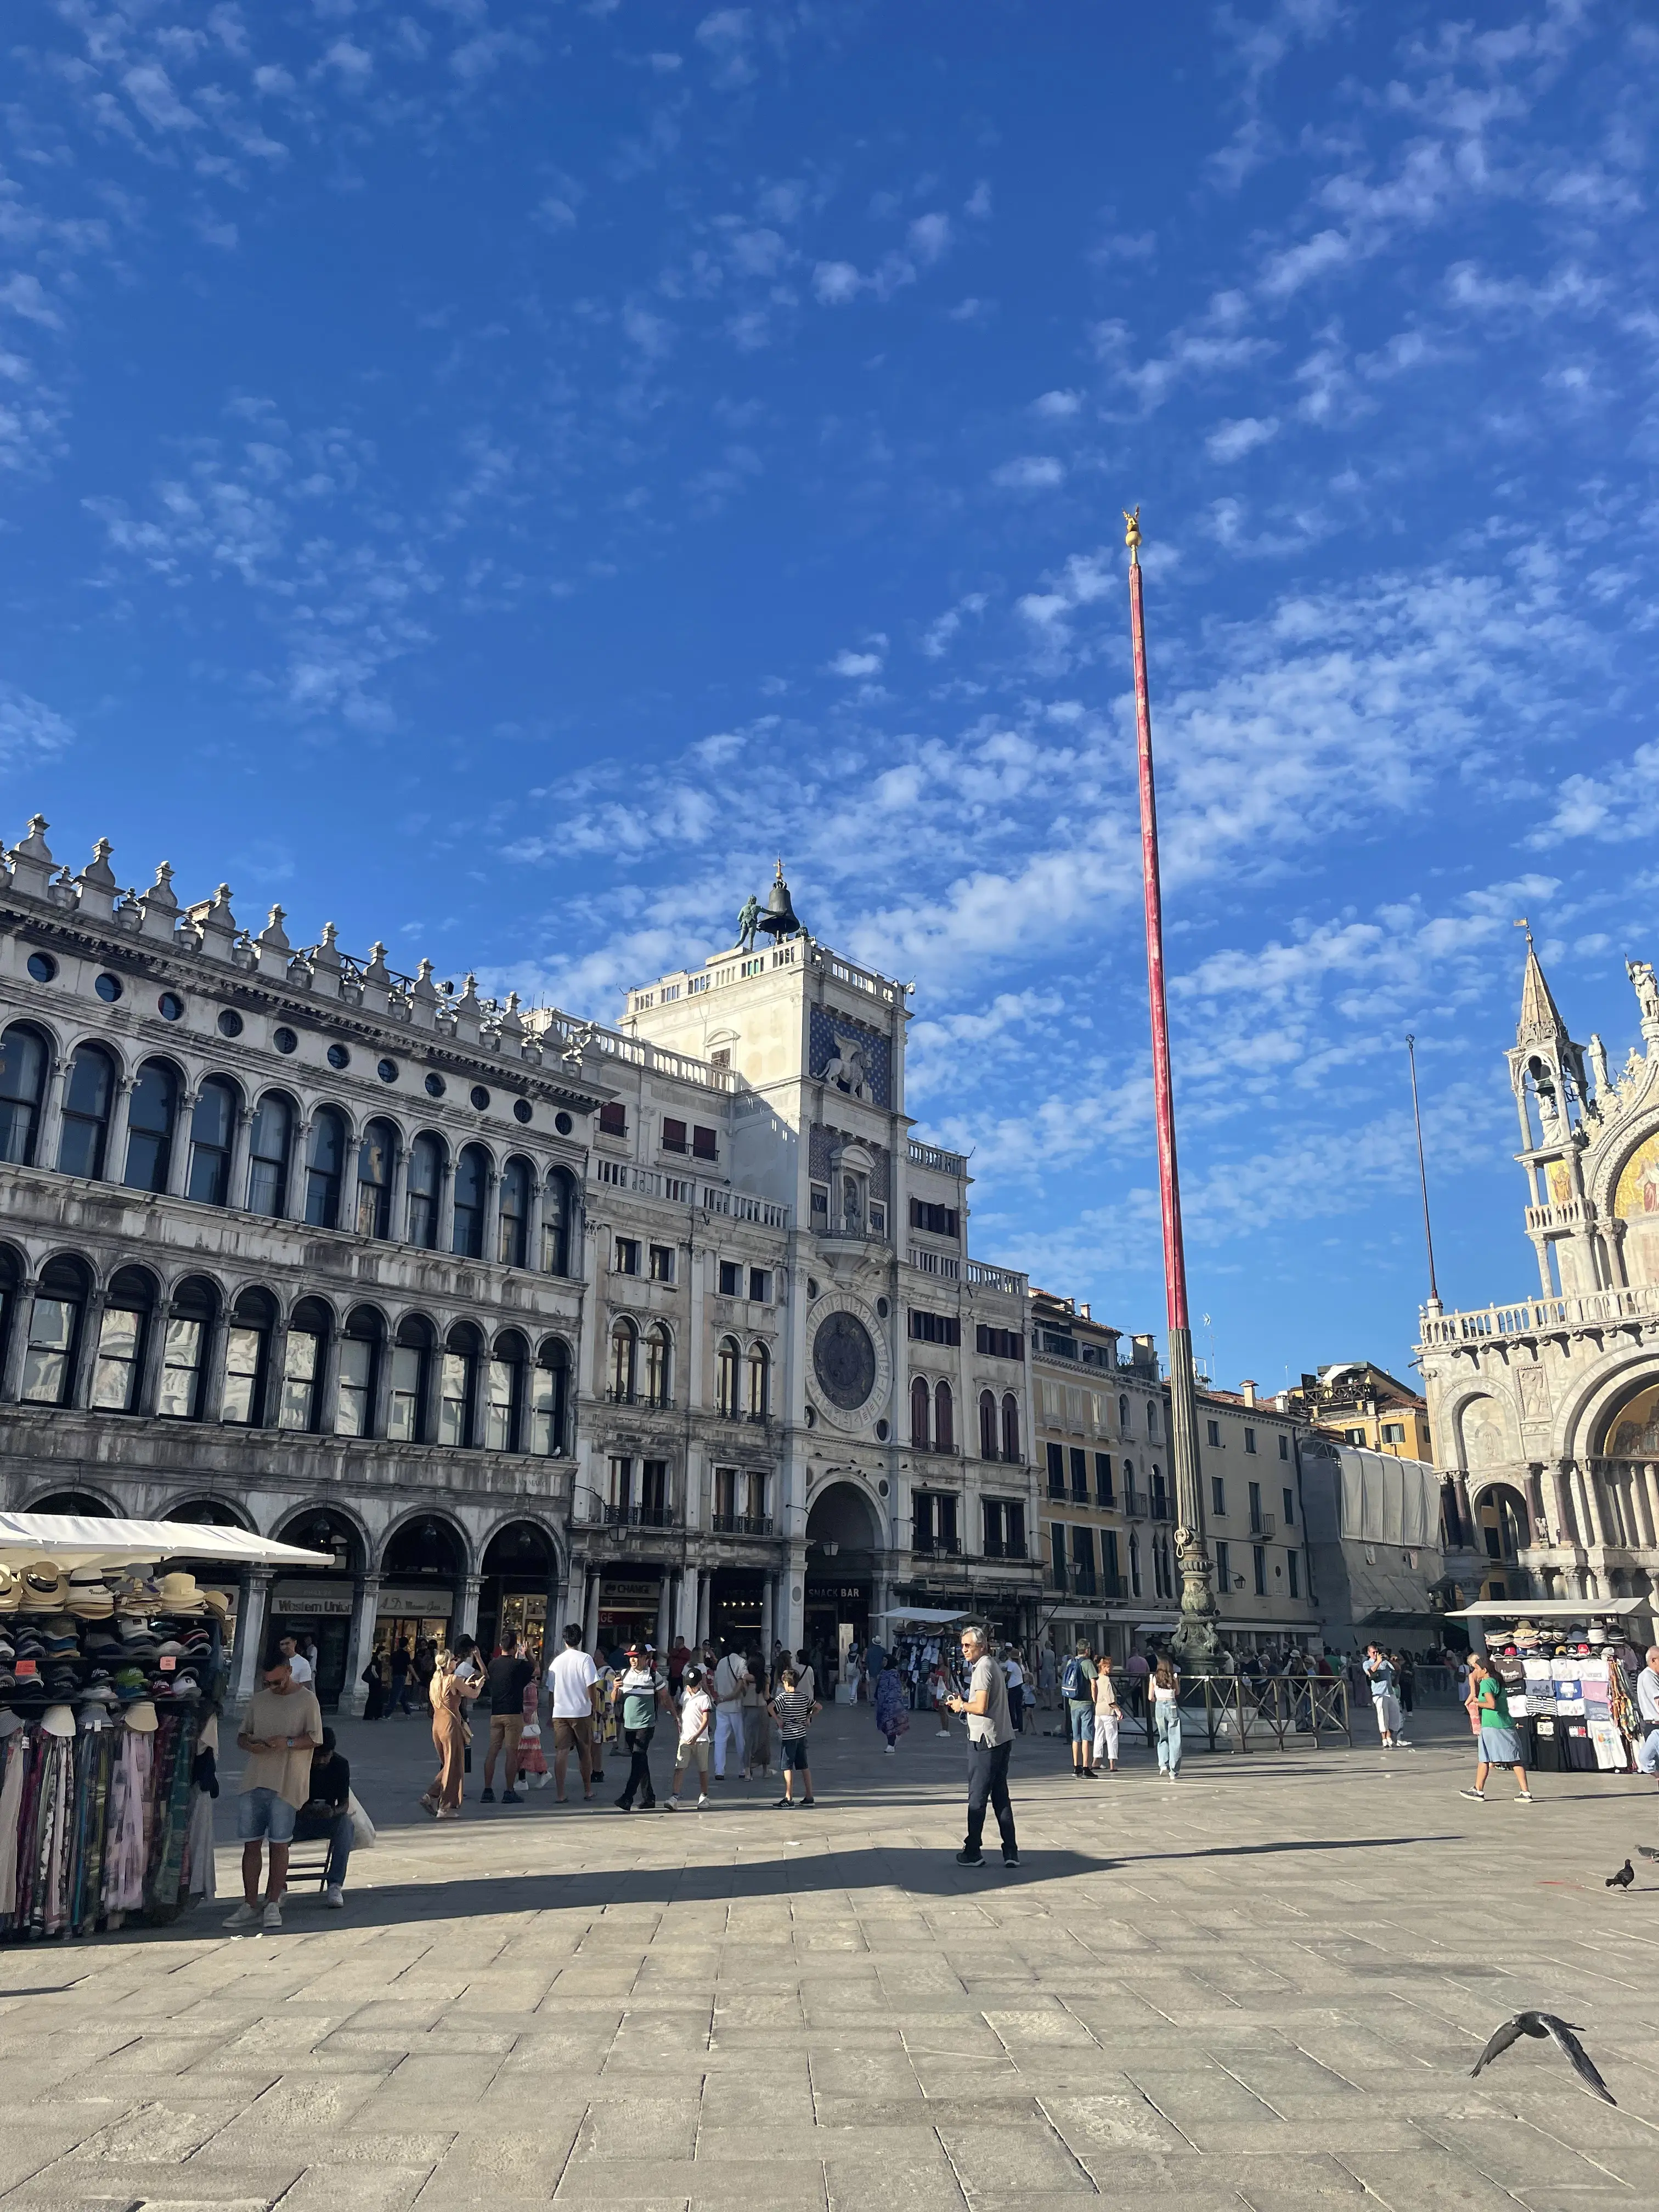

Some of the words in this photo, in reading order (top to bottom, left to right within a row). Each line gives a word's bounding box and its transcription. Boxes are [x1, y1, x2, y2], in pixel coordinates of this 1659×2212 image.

[808, 1588, 838, 1598] SNACK
[840, 1588, 860, 1598] BAR
[279, 1599, 321, 1612] Western
